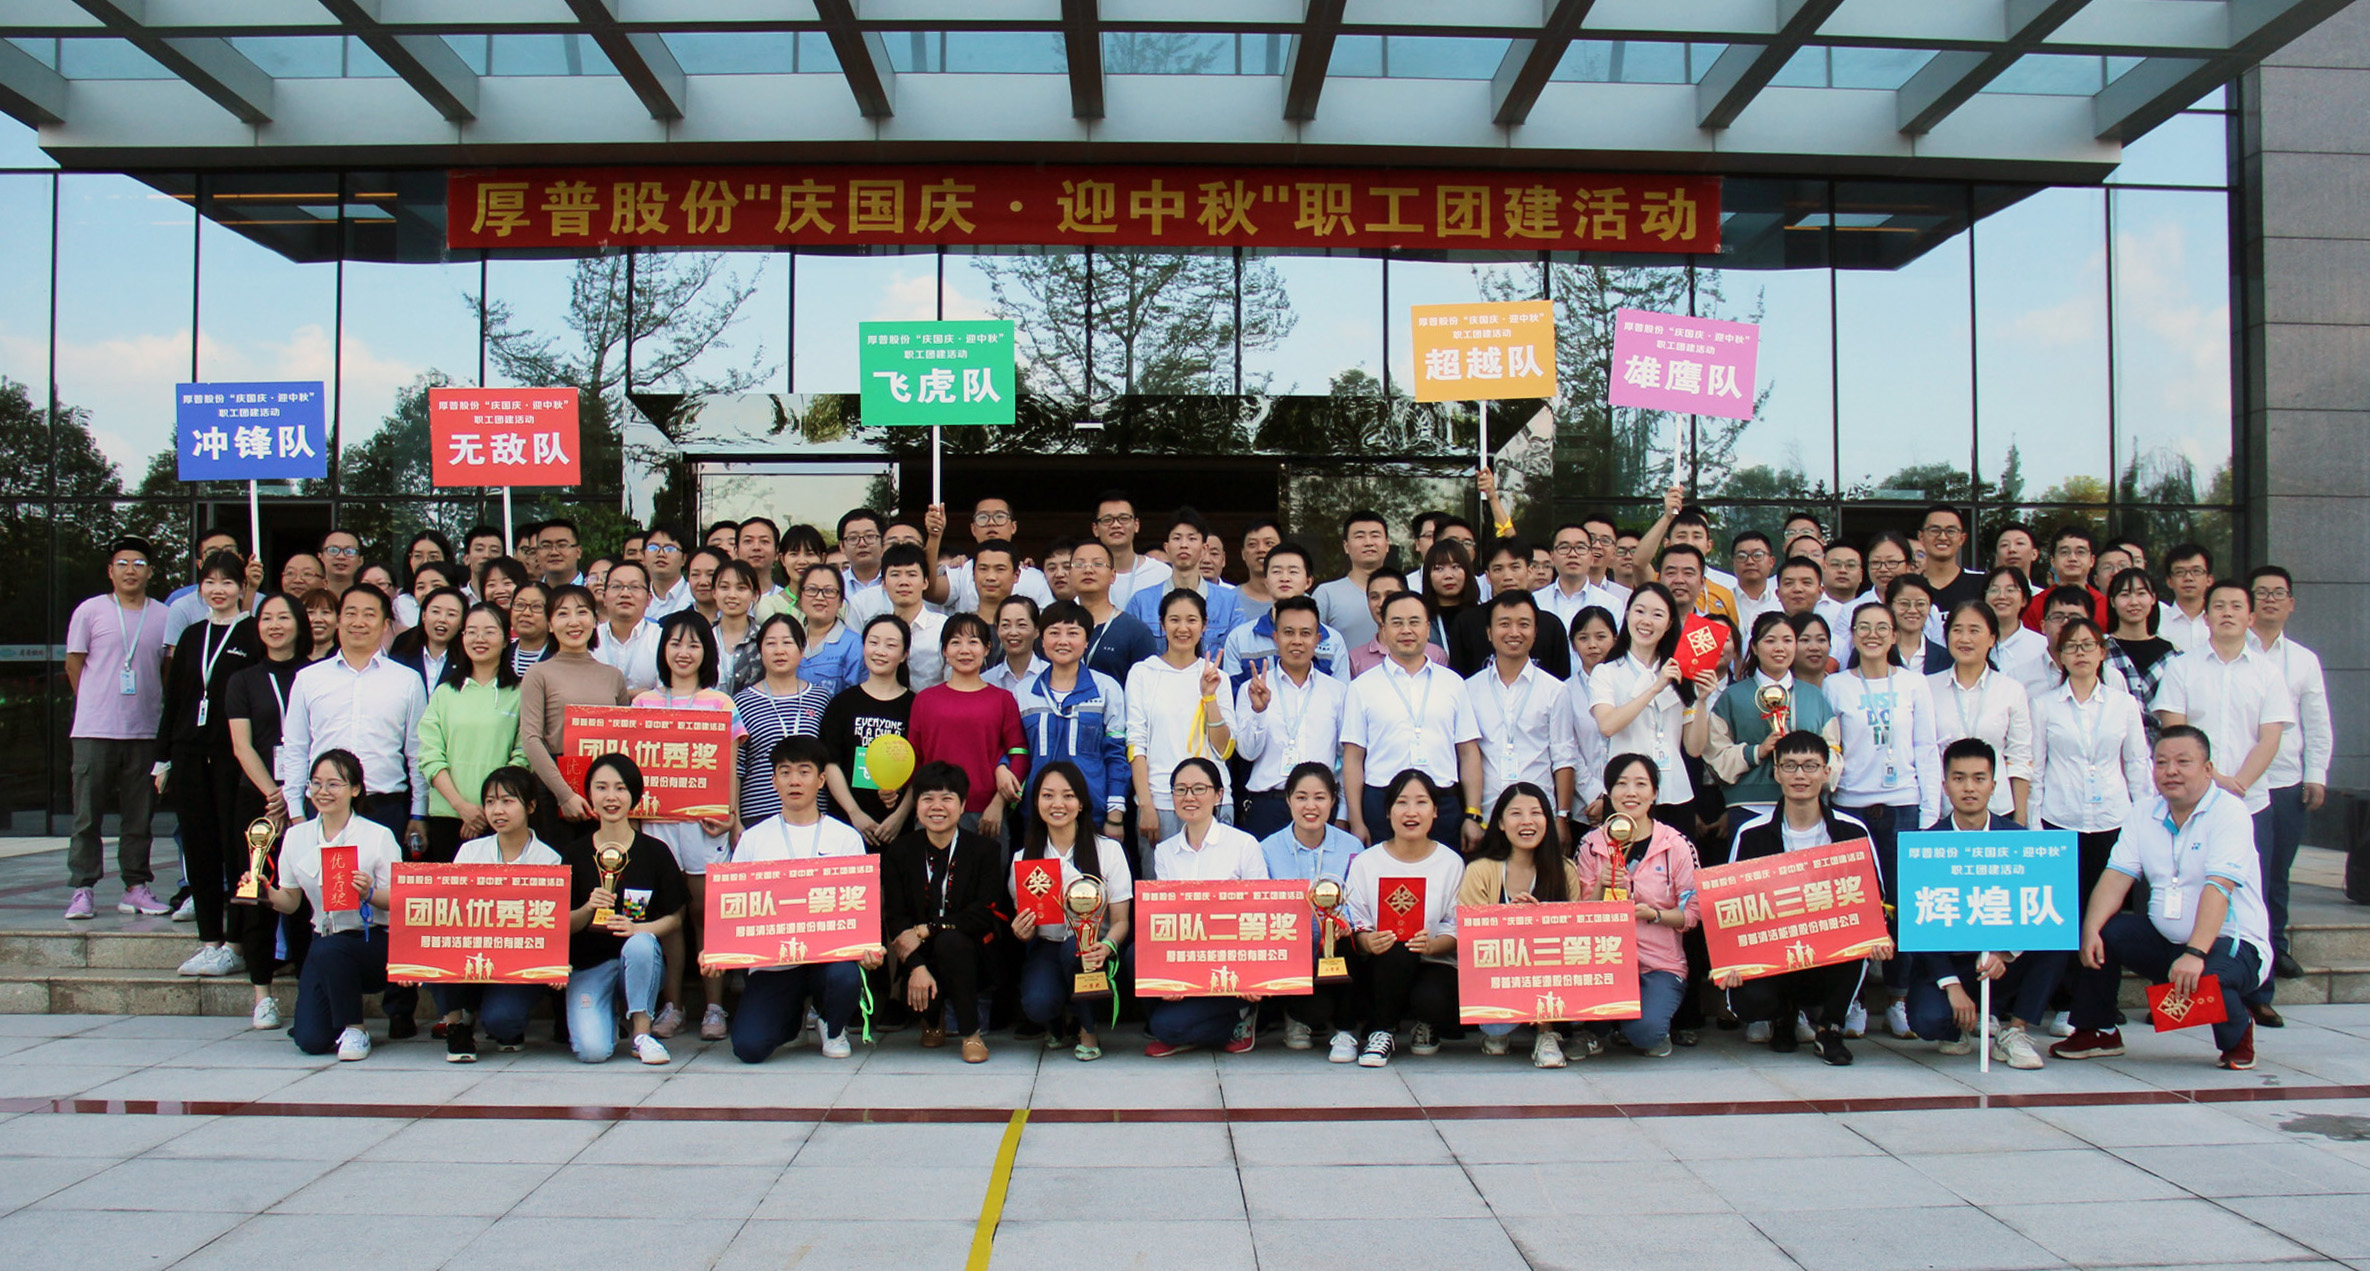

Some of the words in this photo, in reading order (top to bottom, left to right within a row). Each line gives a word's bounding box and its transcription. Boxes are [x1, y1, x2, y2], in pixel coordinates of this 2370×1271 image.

[1453, 330, 1511, 340] 职工团建活动
[1656, 340, 1716, 355] 职工团建活动
[904, 349, 968, 359] 职工团建活动
[1424, 344, 1544, 380] 超越队
[873, 368, 1001, 403] 飞虎队
[1624, 354, 1743, 399] 雄鹰队
[218, 407, 281, 418] 职工团建活动
[474, 414, 535, 425] 职工团建活动
[192, 424, 316, 461] 冲锋队
[448, 433, 571, 466] 无敌队
[1951, 864, 2026, 875] 职工团建活动
[404, 897, 556, 928] 团队优秀奖
[720, 885, 867, 919] 团队一等奖
[1714, 875, 1866, 930] 团队三等奖
[1915, 885, 2064, 927] 辉煌队
[1150, 913, 1297, 942] 团队二等奖
[1473, 936, 1624, 968] 团队三等奖
